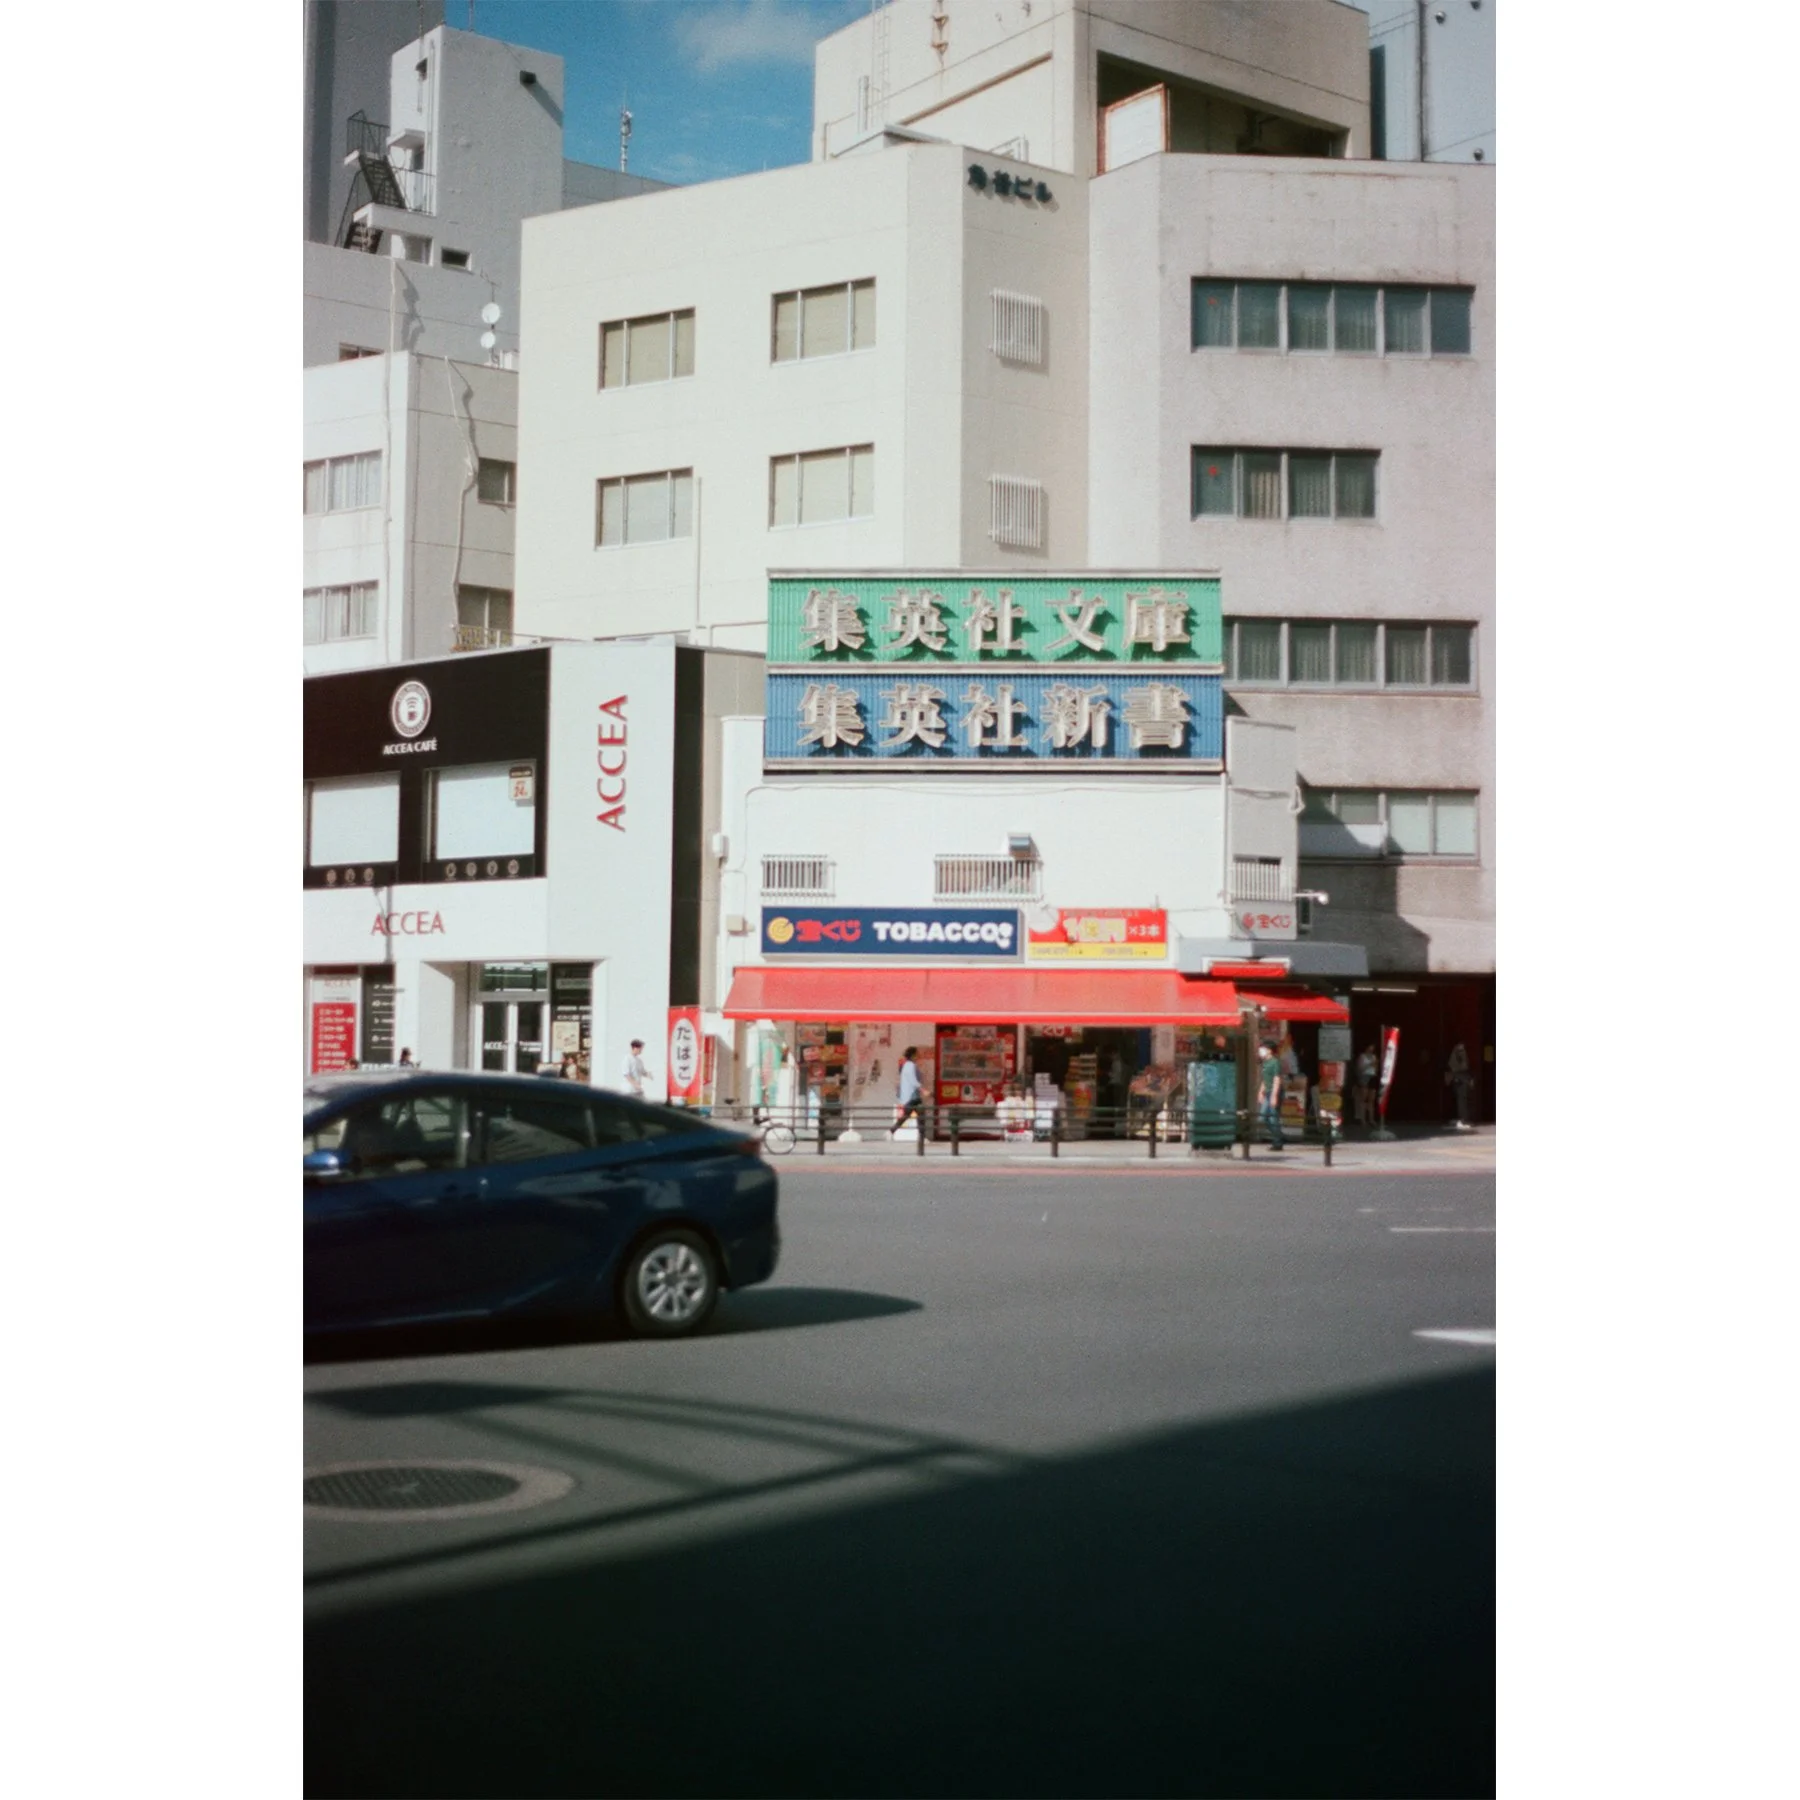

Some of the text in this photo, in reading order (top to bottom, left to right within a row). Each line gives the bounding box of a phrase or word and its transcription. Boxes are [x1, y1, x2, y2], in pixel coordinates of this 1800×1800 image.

[800, 588, 1192, 652] 集英社文庫
[797, 682, 1192, 749] 集英社新書
[383, 742, 413, 755] ACCEA
[597, 695, 628, 832] ACCEA
[371, 911, 445, 936] ACCEA
[796, 919, 861, 942] 宝くじ
[1256, 914, 1292, 929] 宝くじ
